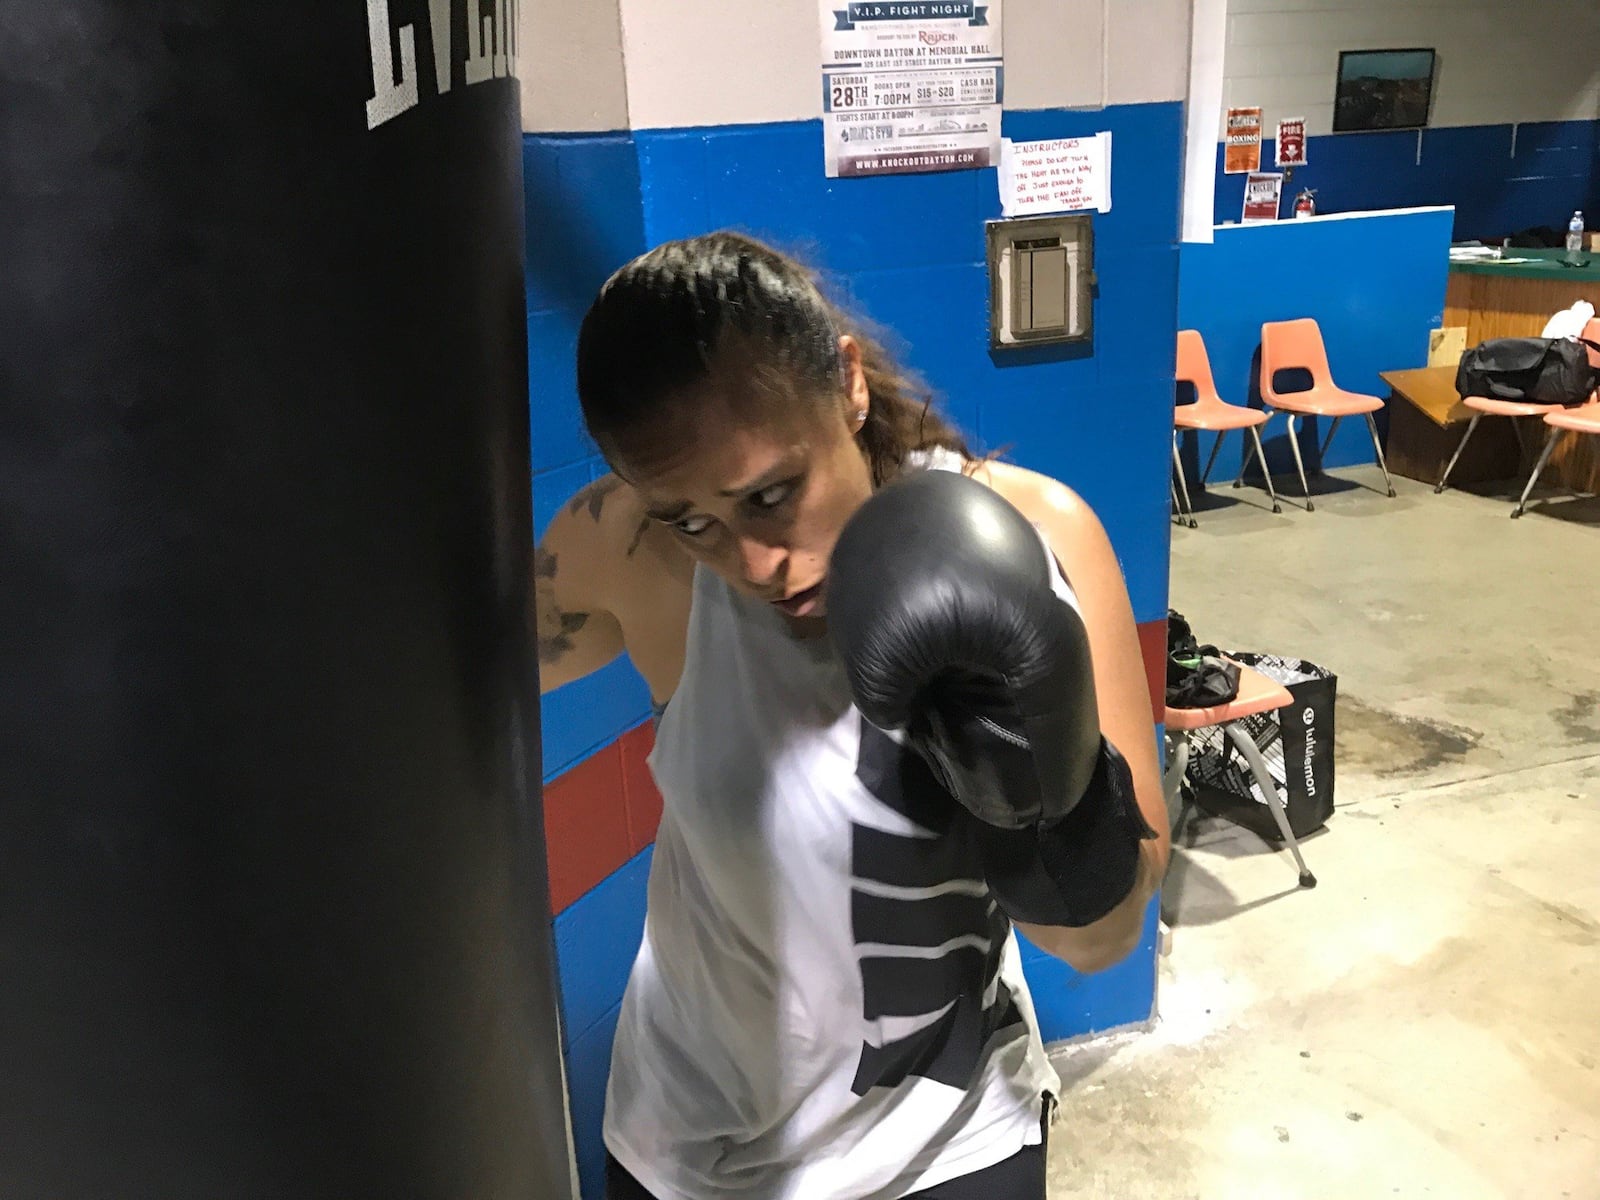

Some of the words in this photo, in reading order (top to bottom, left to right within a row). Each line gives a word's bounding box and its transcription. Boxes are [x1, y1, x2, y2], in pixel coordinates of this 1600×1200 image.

[854, 7, 885, 16] V.I.P.
[890, 6, 926, 15] FIGHT
[932, 5, 969, 14] NIGHT
[834, 50, 881, 60] DOWNTOWN
[884, 48, 914, 58] DAYTON
[917, 48, 926, 56] AT
[929, 46, 968, 56] MEMORIAL
[971, 45, 991, 54] HALL
[832, 76, 868, 85] SATURDAY
[961, 79, 978, 87] CASH
[980, 78, 994, 86] BAR
[874, 93, 911, 105] 7:00PM
[836, 114, 858, 122] FIGHTS
[860, 112, 880, 121] START
[1283, 125, 1301, 135] FIRE
[1227, 134, 1259, 144] BOXING
[1013, 140, 1080, 154] INSTRUCTORS
[856, 153, 974, 169] WWW.KNOCKOUTDAYTON.COM
[1054, 191, 1069, 199] FAN
[1303, 727, 1316, 797] lululemon
